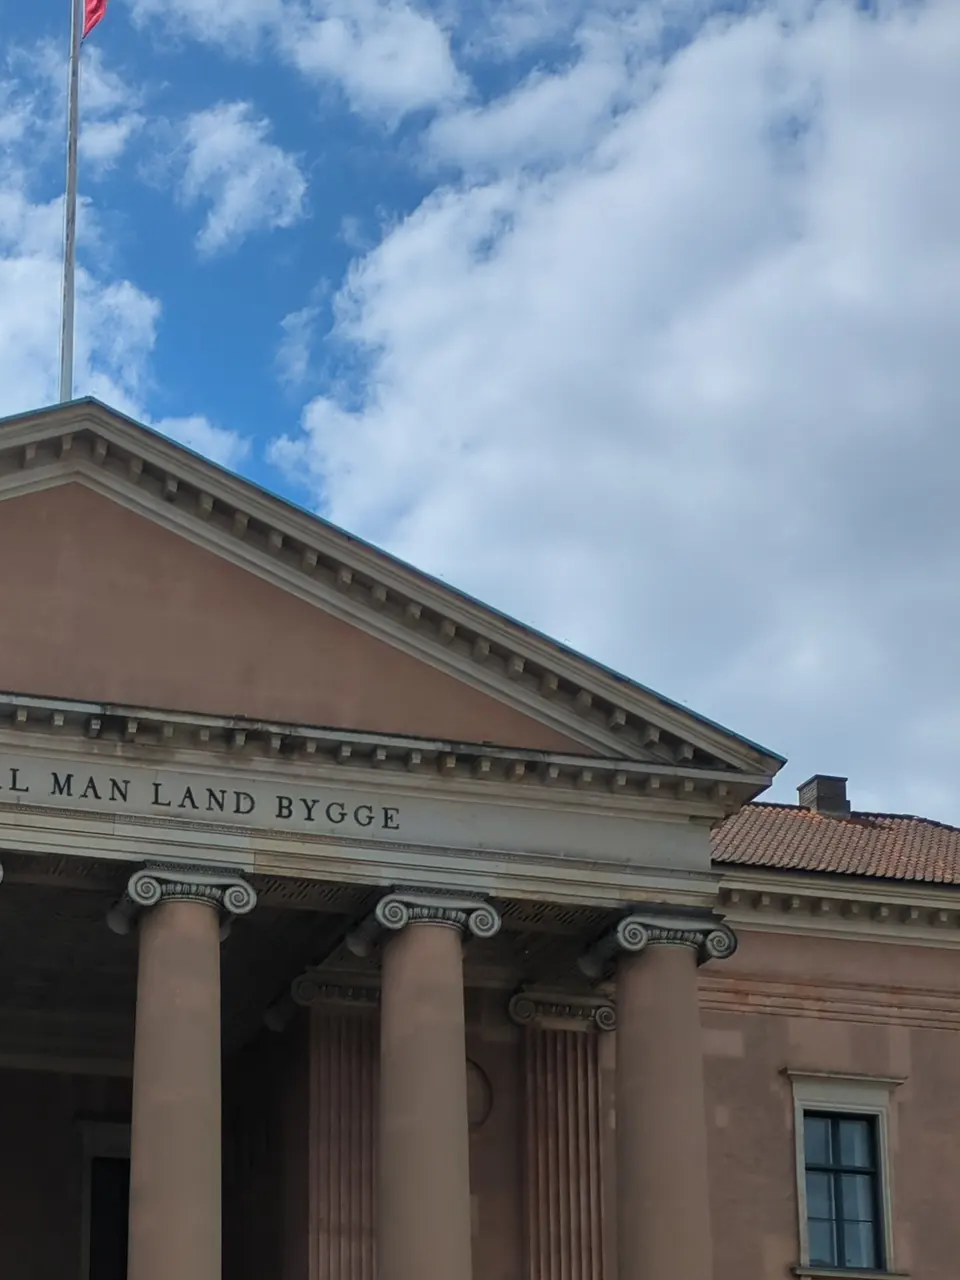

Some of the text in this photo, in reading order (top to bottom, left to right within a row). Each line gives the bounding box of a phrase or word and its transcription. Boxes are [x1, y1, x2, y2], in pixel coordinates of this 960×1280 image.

[50, 771, 131, 803] MAN
[151, 782, 256, 815] LAND
[274, 795, 401, 831] BYGGE
